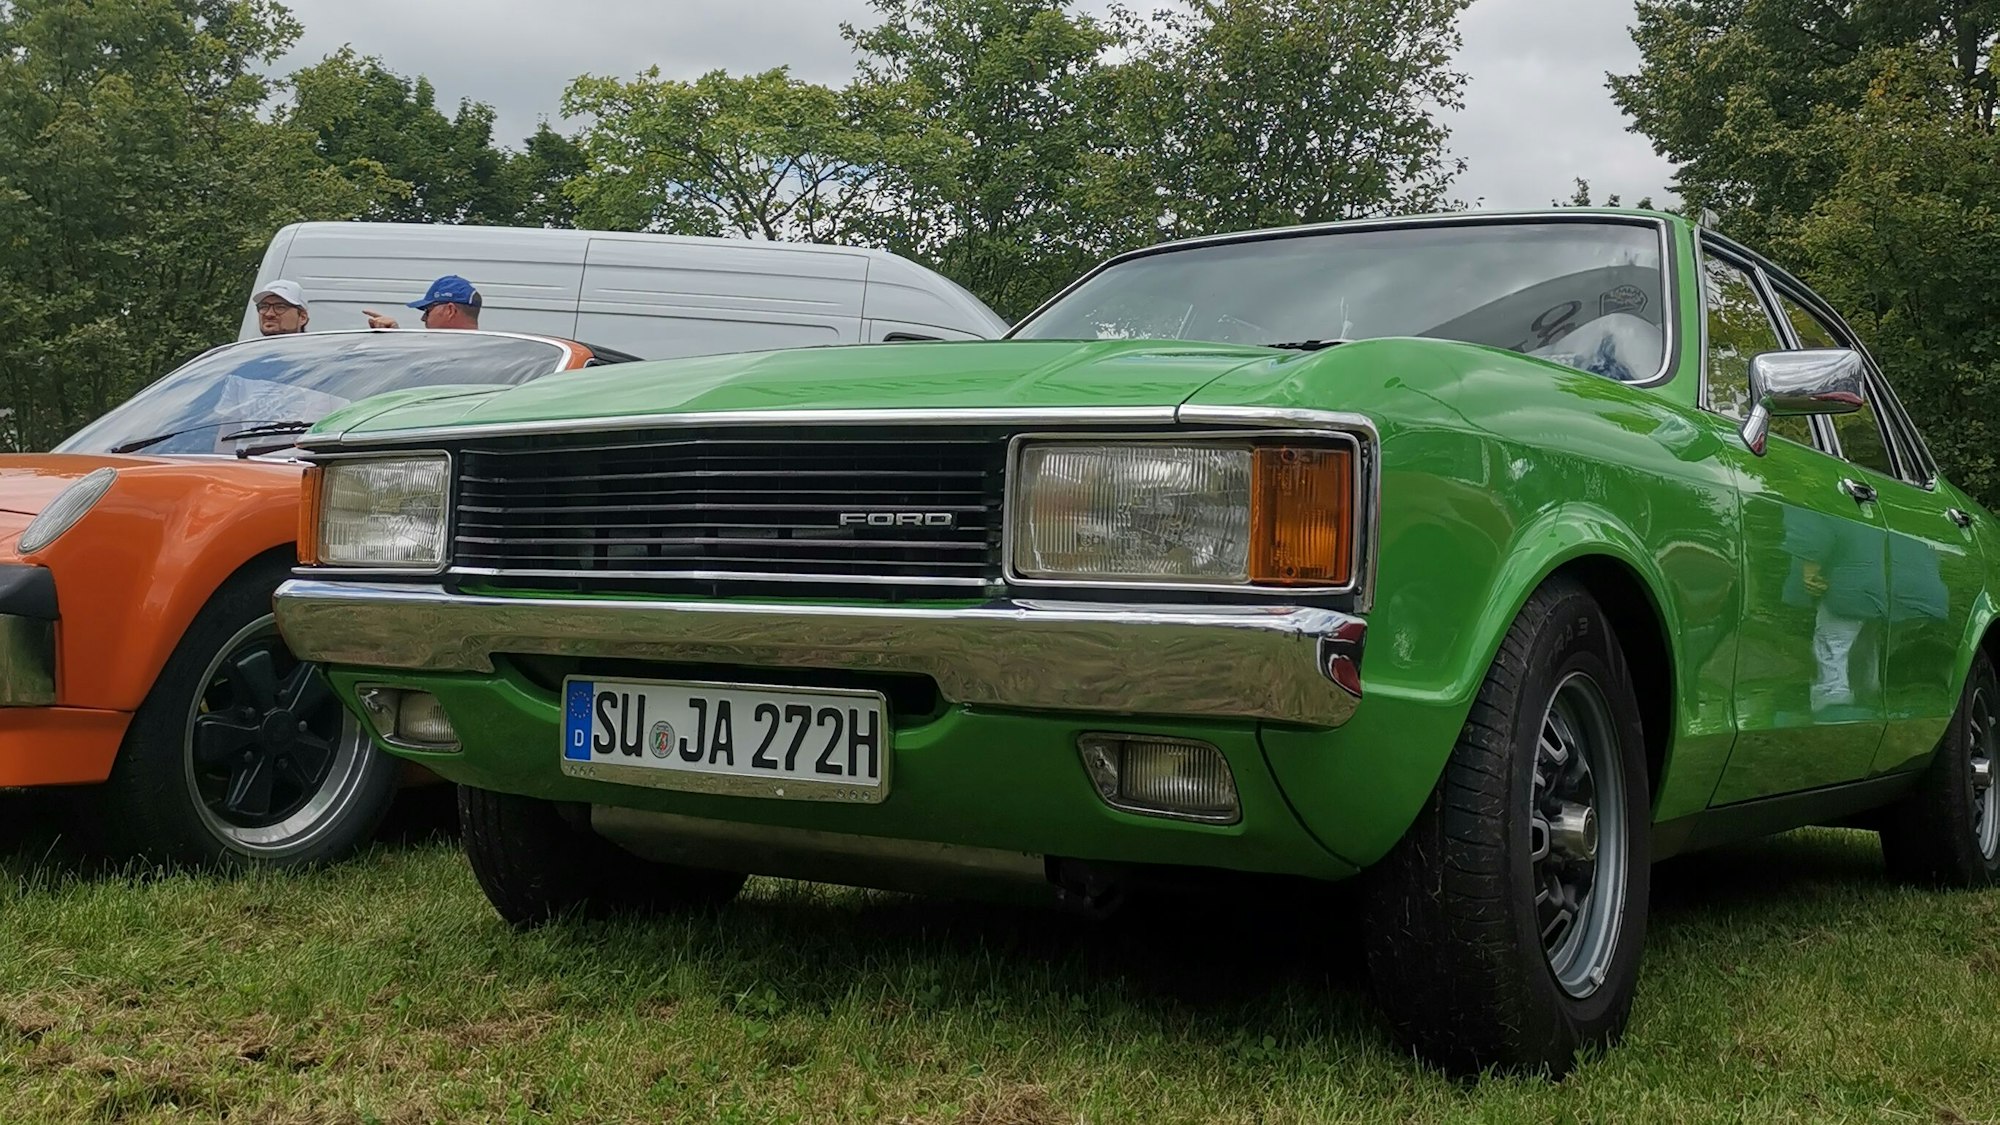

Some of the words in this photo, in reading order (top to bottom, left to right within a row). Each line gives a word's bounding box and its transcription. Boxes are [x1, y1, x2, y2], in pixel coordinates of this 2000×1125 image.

[840, 512, 953, 526] FORD
[574, 728, 584, 747] D
[593, 691, 646, 758] SU
[679, 698, 734, 766] JA
[751, 703, 879, 778] 272H
